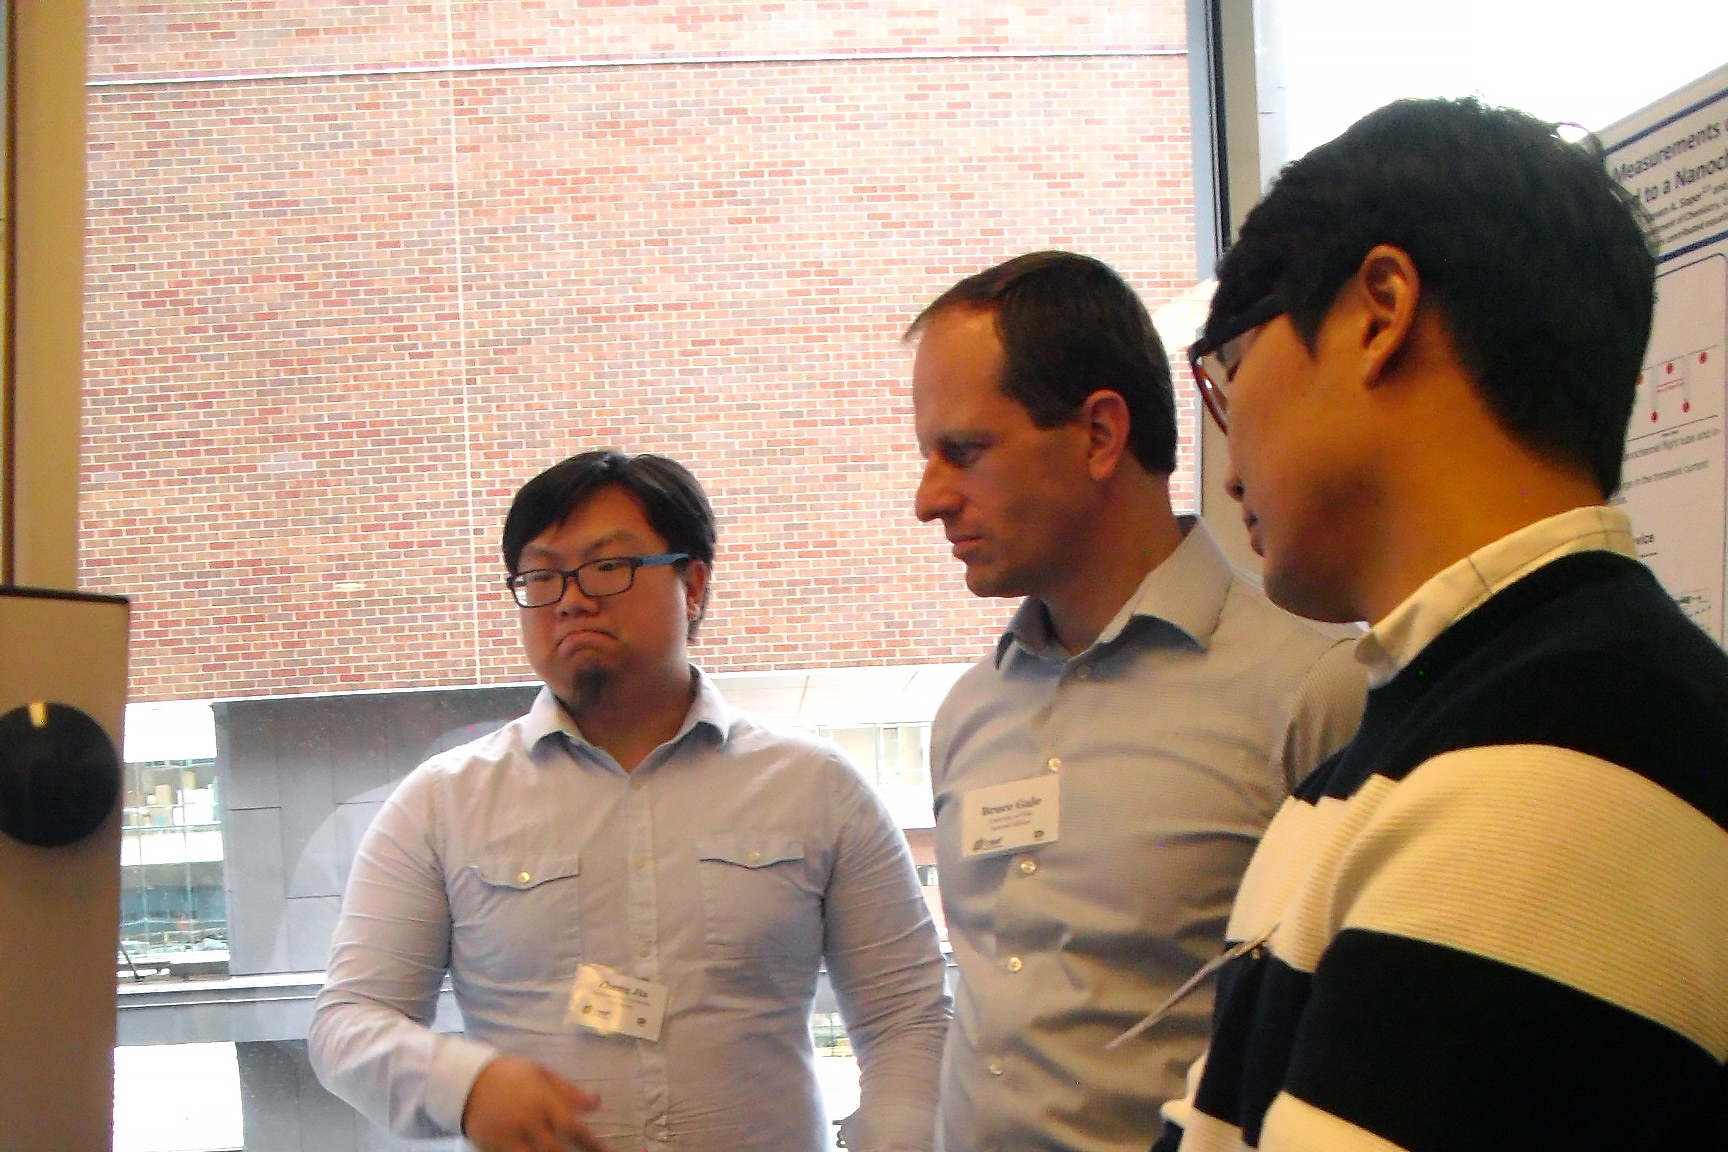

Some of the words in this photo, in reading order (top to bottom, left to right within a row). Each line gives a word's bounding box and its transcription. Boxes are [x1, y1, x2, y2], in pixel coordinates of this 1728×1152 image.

[1612, 123, 1720, 183] Measurements
[1645, 186, 1658, 202] to
[1662, 181, 1671, 195] a
